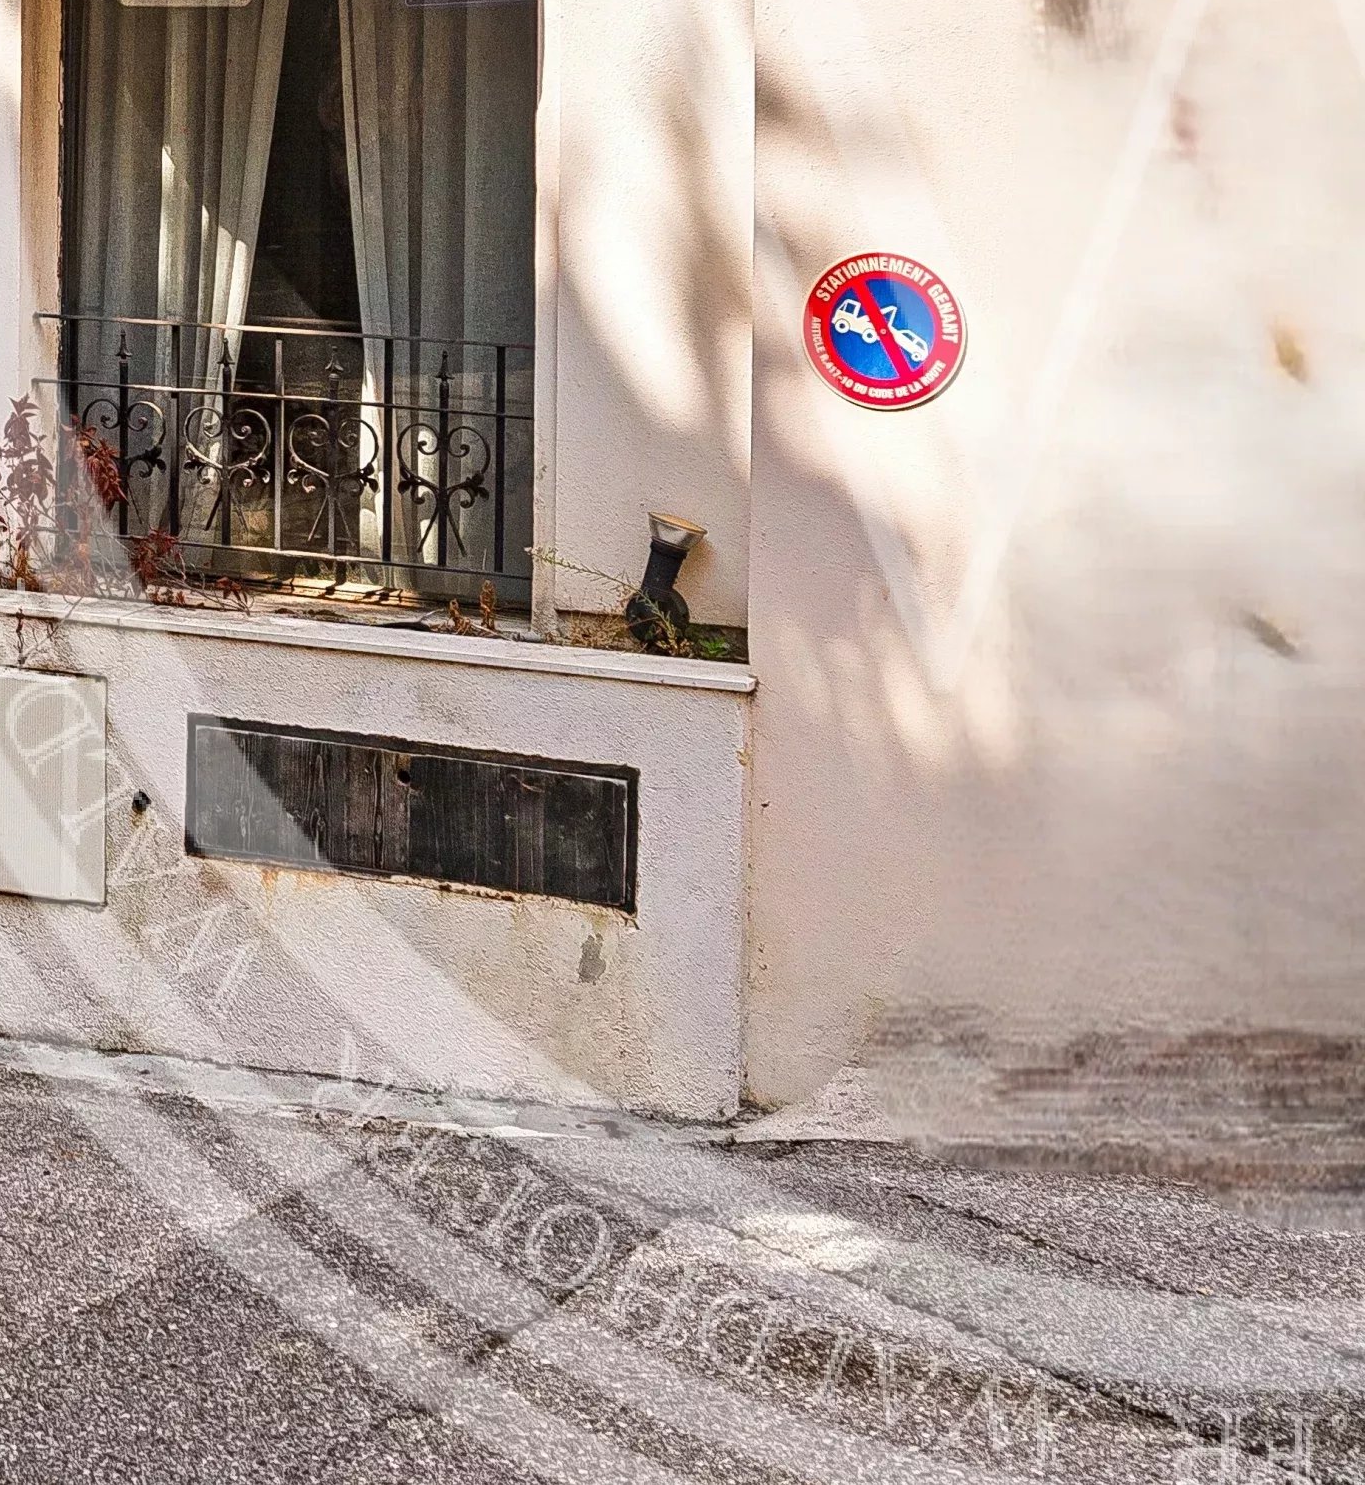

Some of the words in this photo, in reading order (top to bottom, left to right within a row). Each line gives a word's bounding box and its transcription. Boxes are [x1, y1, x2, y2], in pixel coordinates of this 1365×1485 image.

[816, 256, 933, 302] STATIONNEMENT
[927, 283, 959, 344] GENANT
[811, 316, 826, 353] ARTICLE
[852, 382, 868, 395] DU
[868, 387, 895, 399] CODE
[894, 385, 910, 398] DE
[907, 381, 924, 394] LA
[919, 359, 947, 387] ROUTE
